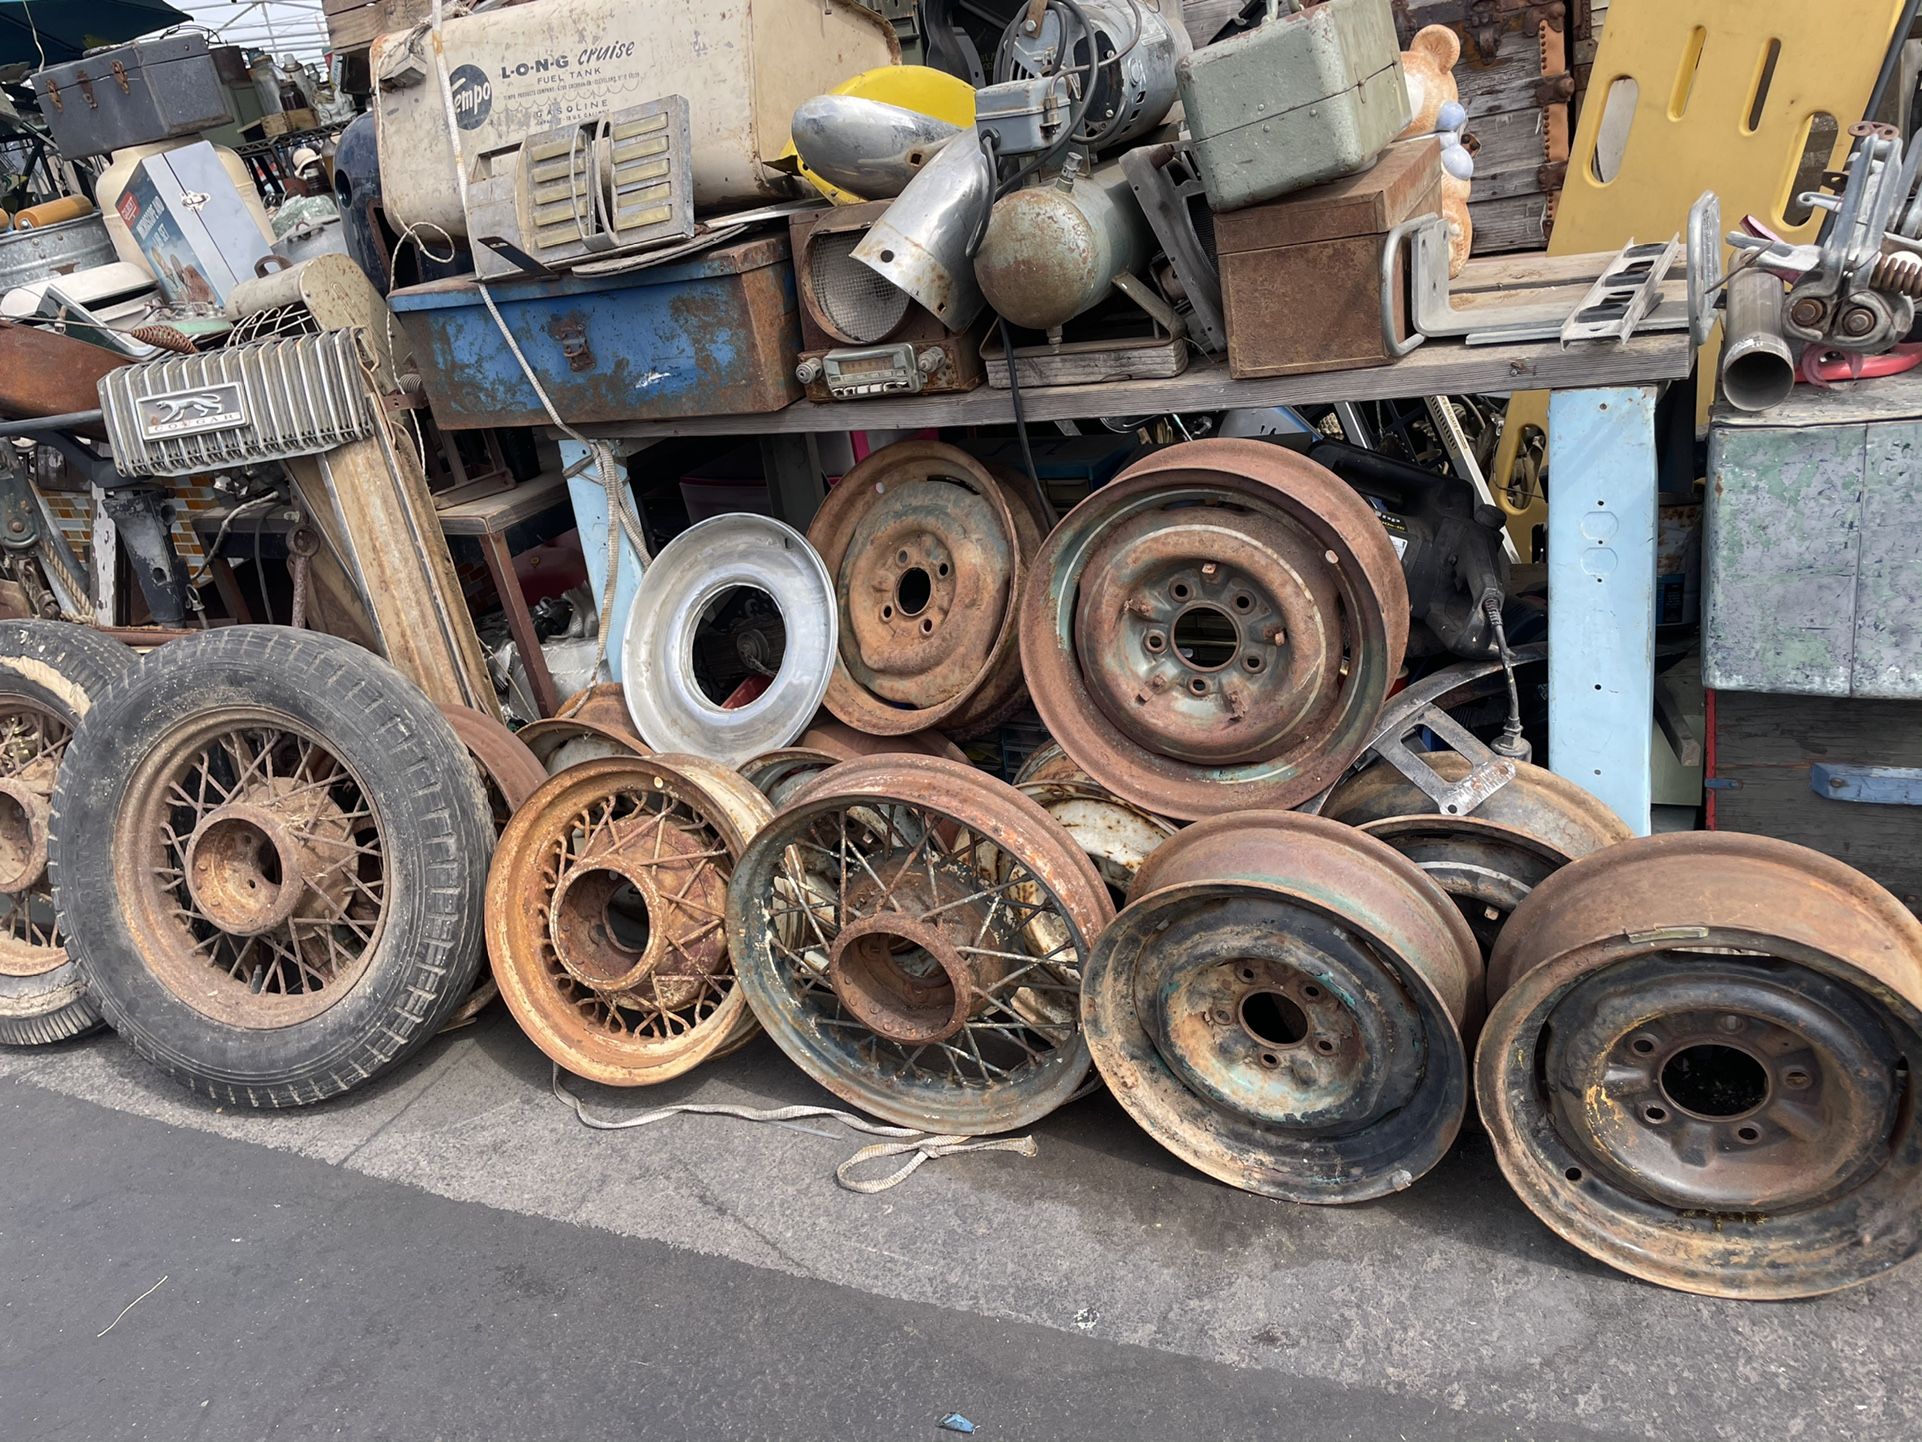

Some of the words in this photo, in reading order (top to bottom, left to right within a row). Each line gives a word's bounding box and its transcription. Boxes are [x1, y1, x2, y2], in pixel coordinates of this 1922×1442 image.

[577, 40, 636, 66] cruise
[537, 74, 564, 85] FUEL
[569, 67, 602, 80] TANK
[535, 100, 608, 119] GASOLINE
[155, 414, 233, 432] COUGAR
